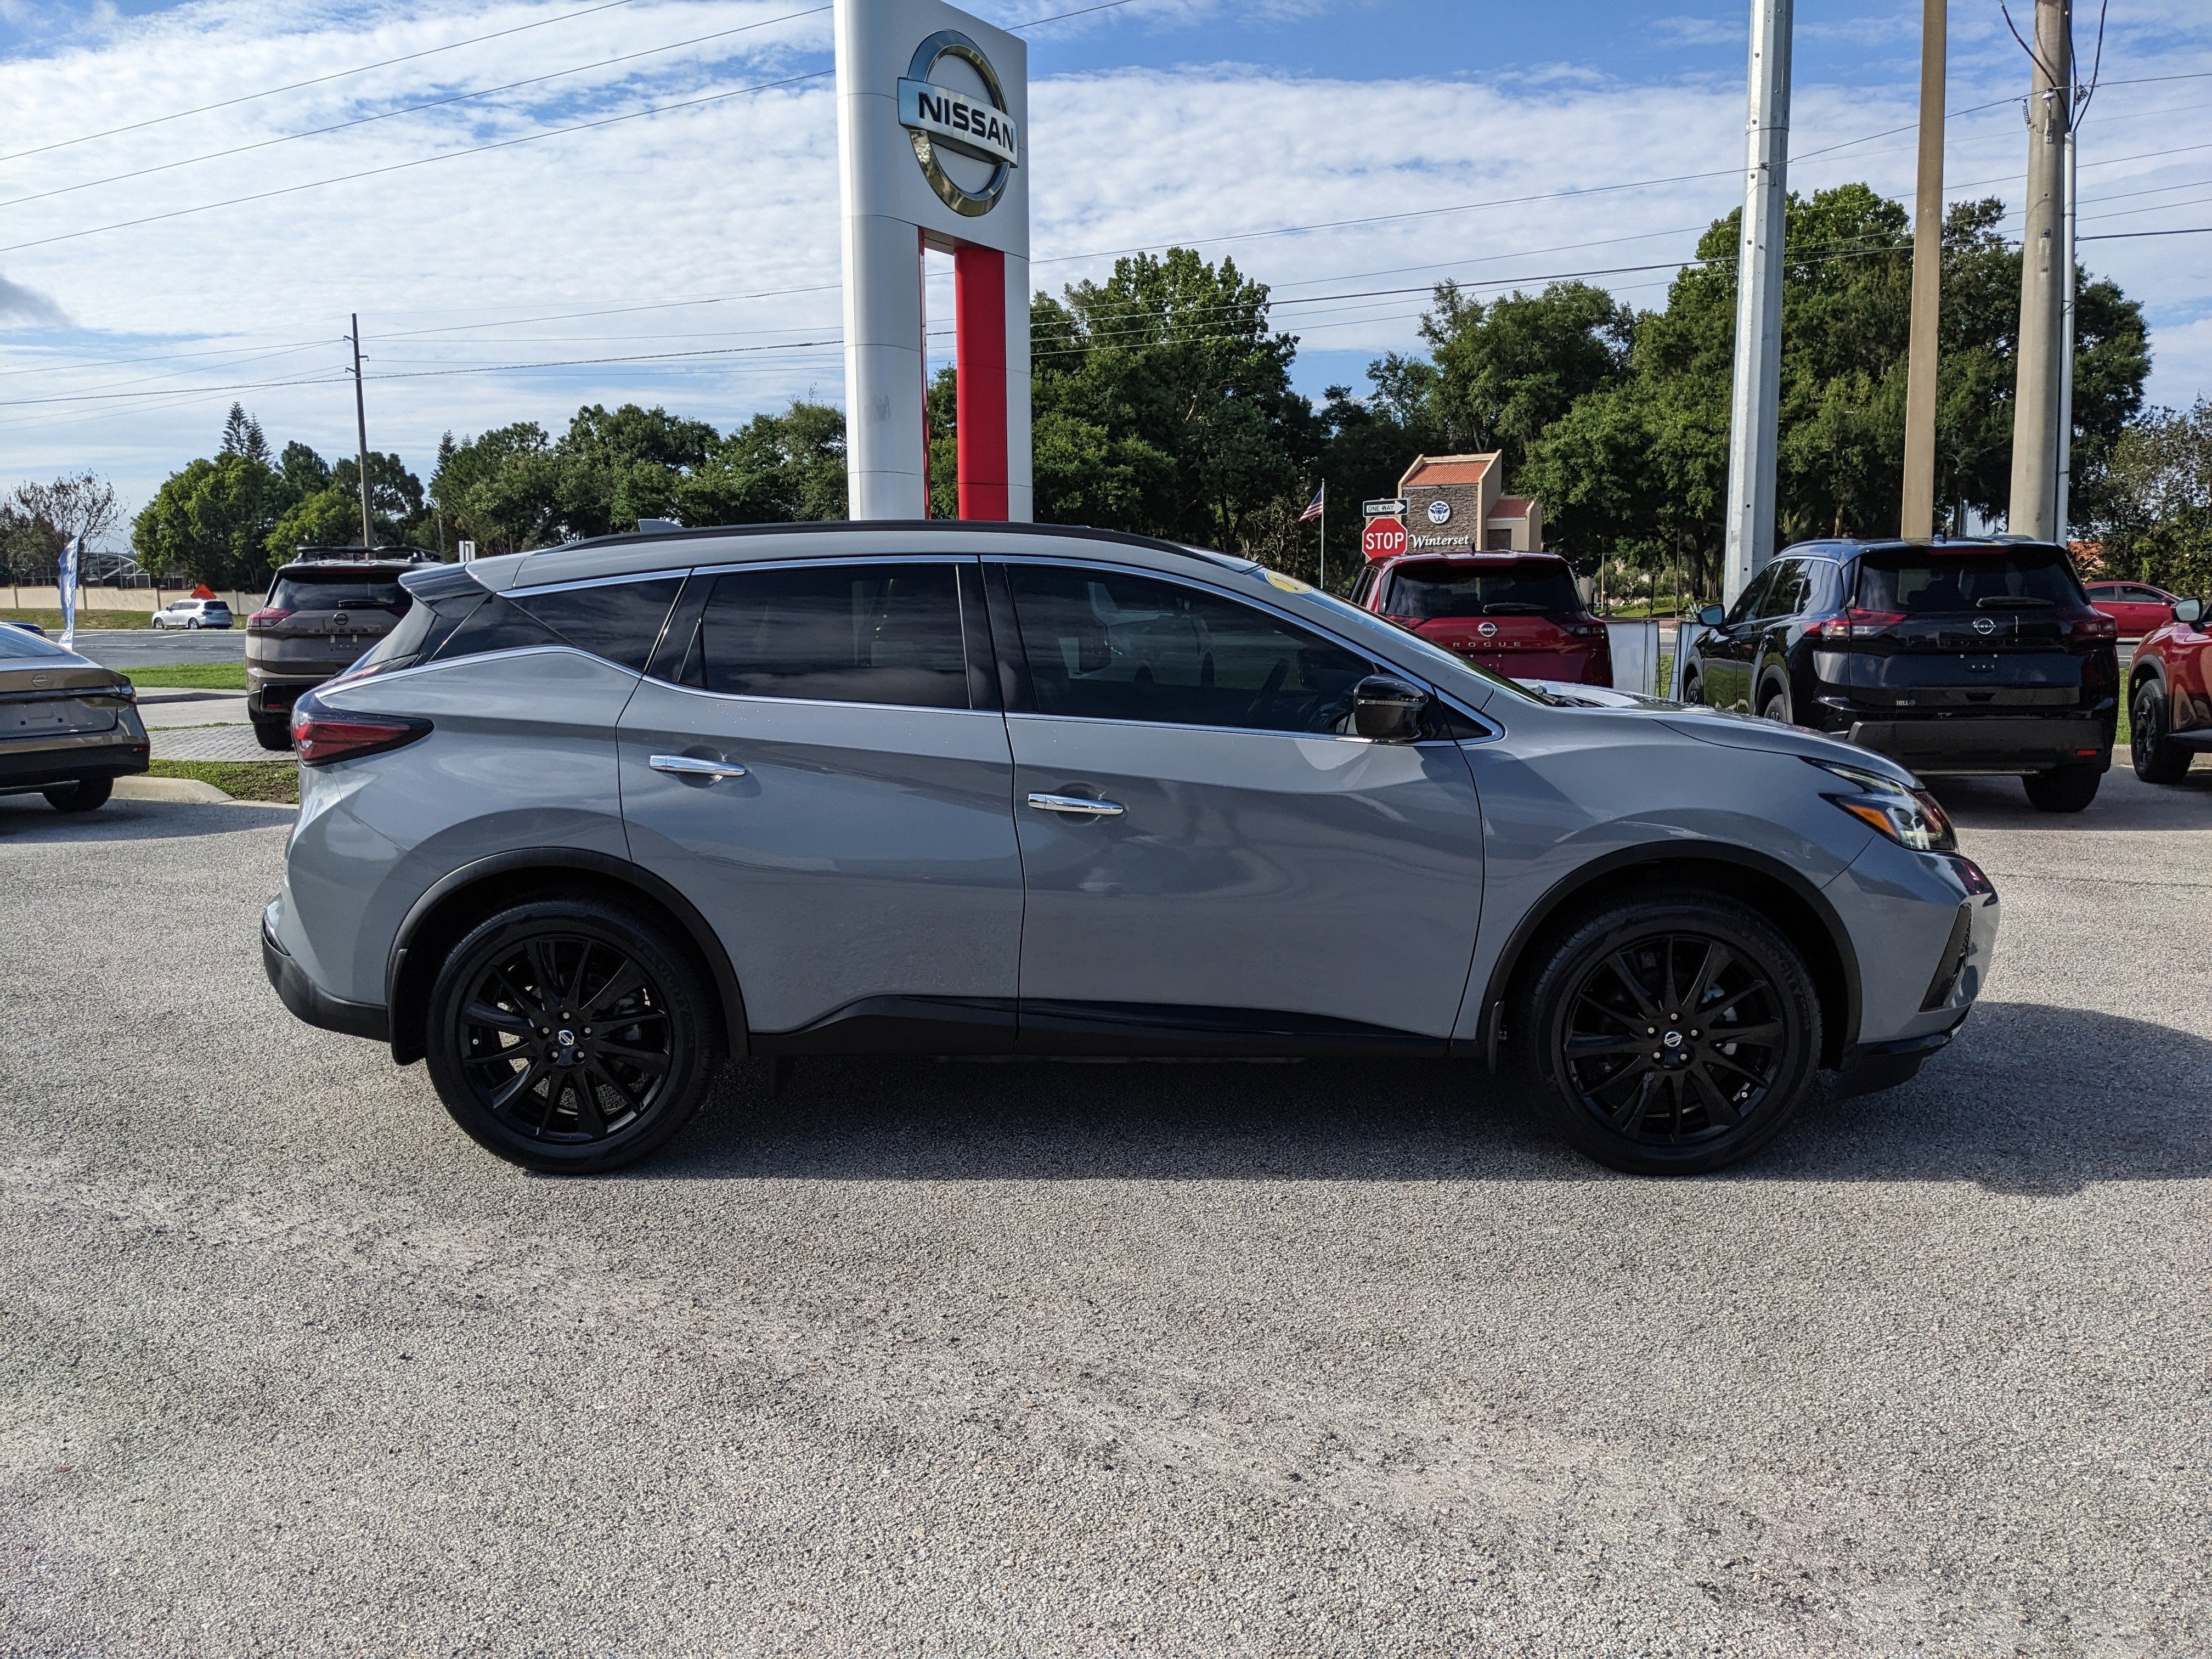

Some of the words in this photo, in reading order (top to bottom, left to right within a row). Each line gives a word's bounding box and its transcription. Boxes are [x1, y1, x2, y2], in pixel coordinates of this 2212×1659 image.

[918, 92, 1014, 153] NISSAN
[1365, 532, 1404, 550] STOP
[1408, 534, 1470, 548] Winterset
